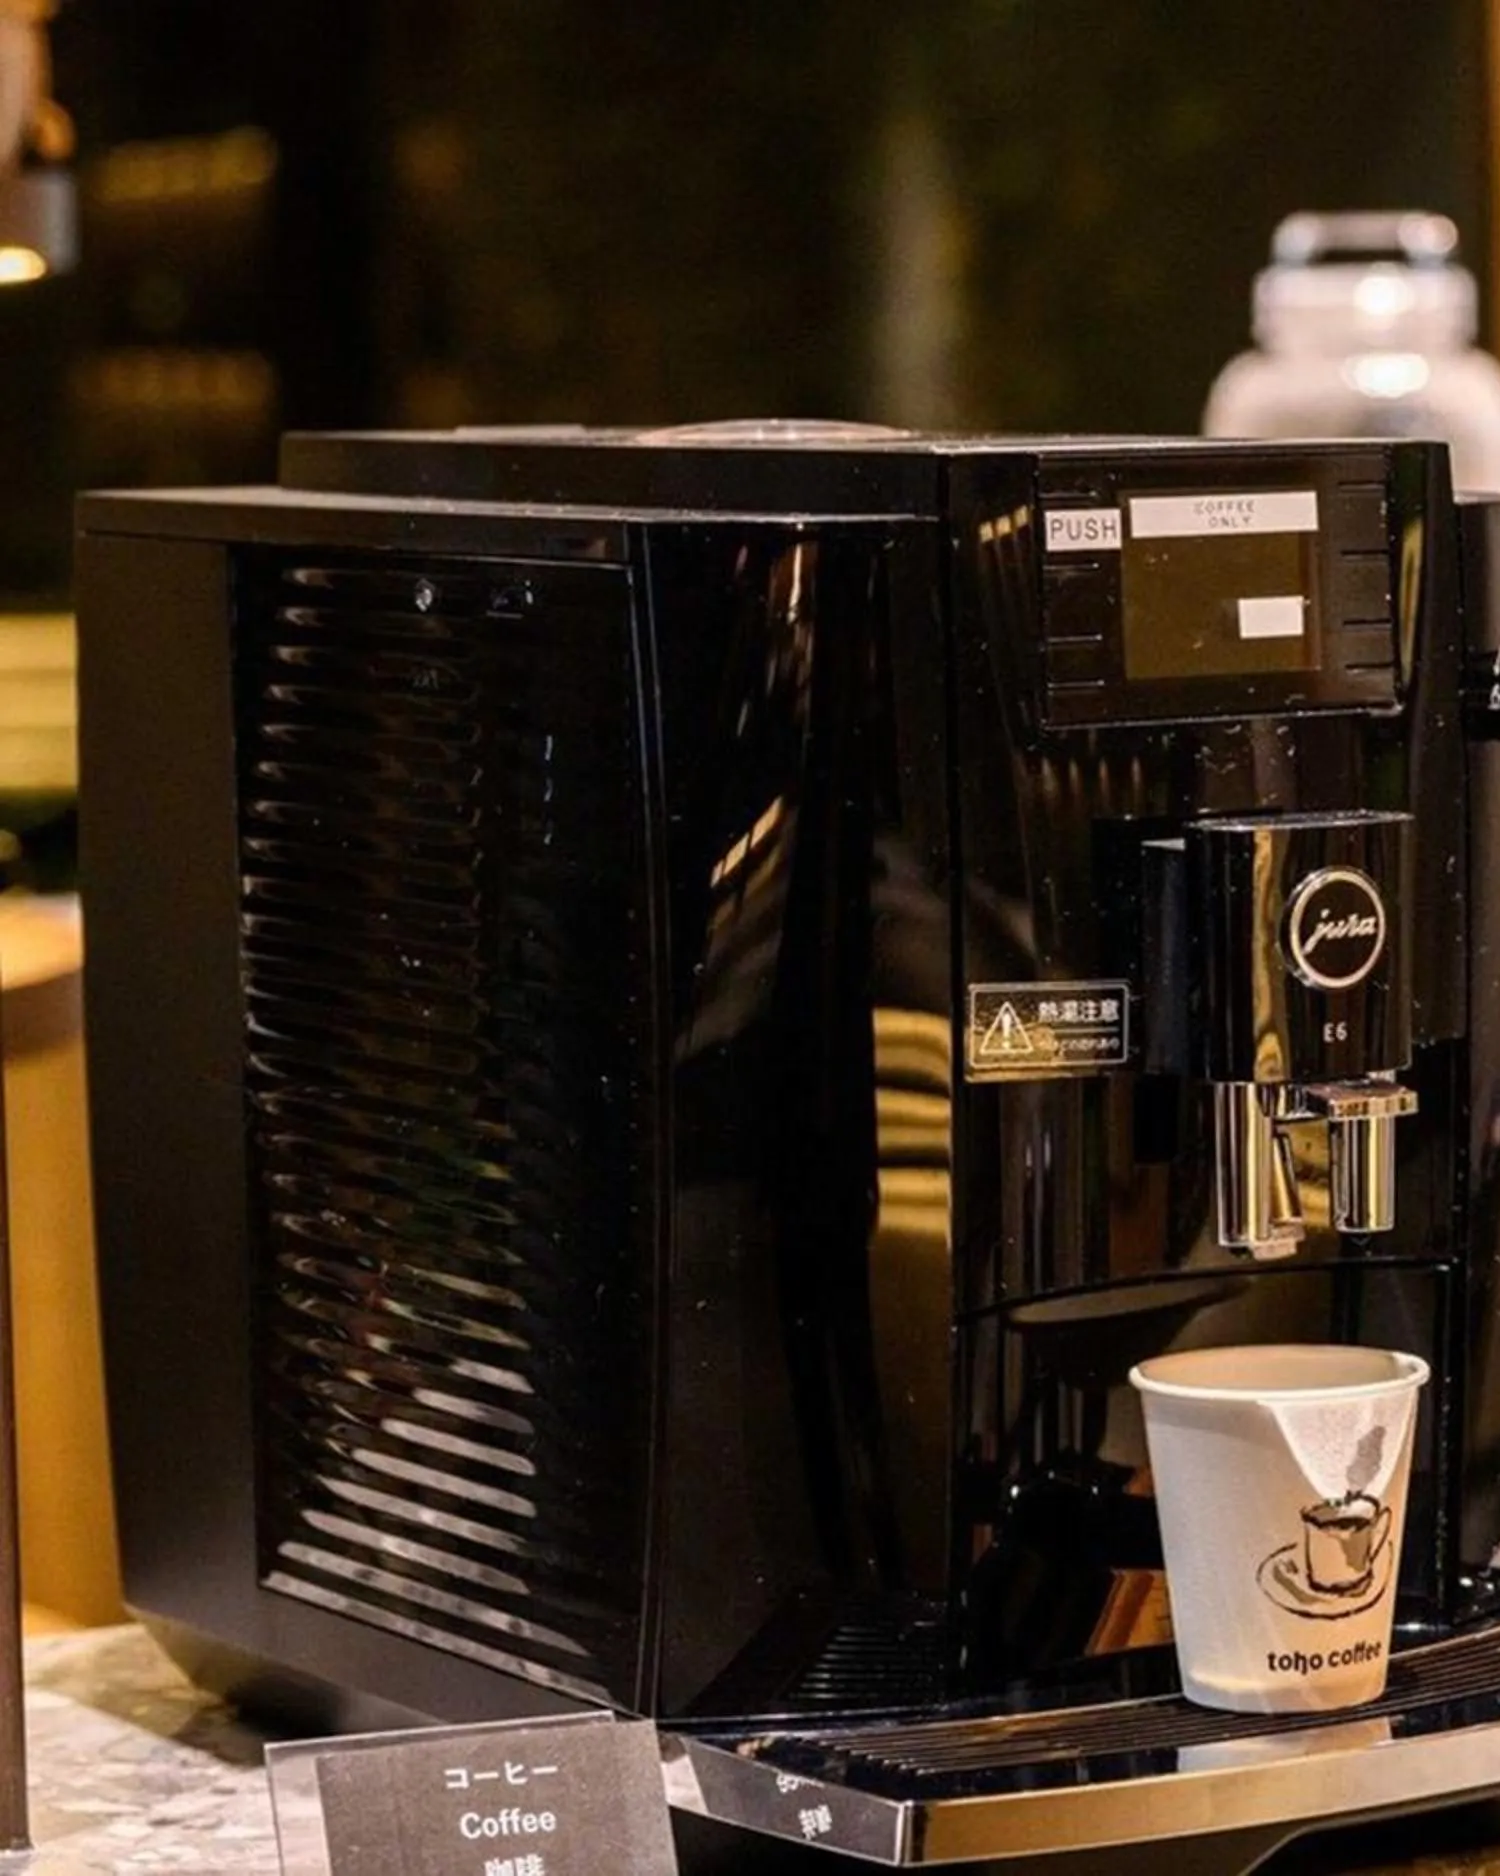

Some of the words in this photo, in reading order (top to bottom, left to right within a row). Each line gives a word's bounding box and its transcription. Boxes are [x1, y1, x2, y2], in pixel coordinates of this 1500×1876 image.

[1193, 500, 1255, 515] COFFEE
[1050, 517, 1118, 541] PUSH
[1208, 515, 1252, 529] ONLY
[1302, 908, 1377, 955] jura
[1322, 1021, 1349, 1043] E6
[1267, 1650, 1323, 1675] toho
[1328, 1640, 1382, 1668] coffee
[444, 1760, 558, 1789] コーヒー
[460, 1807, 557, 1839] Coffee
